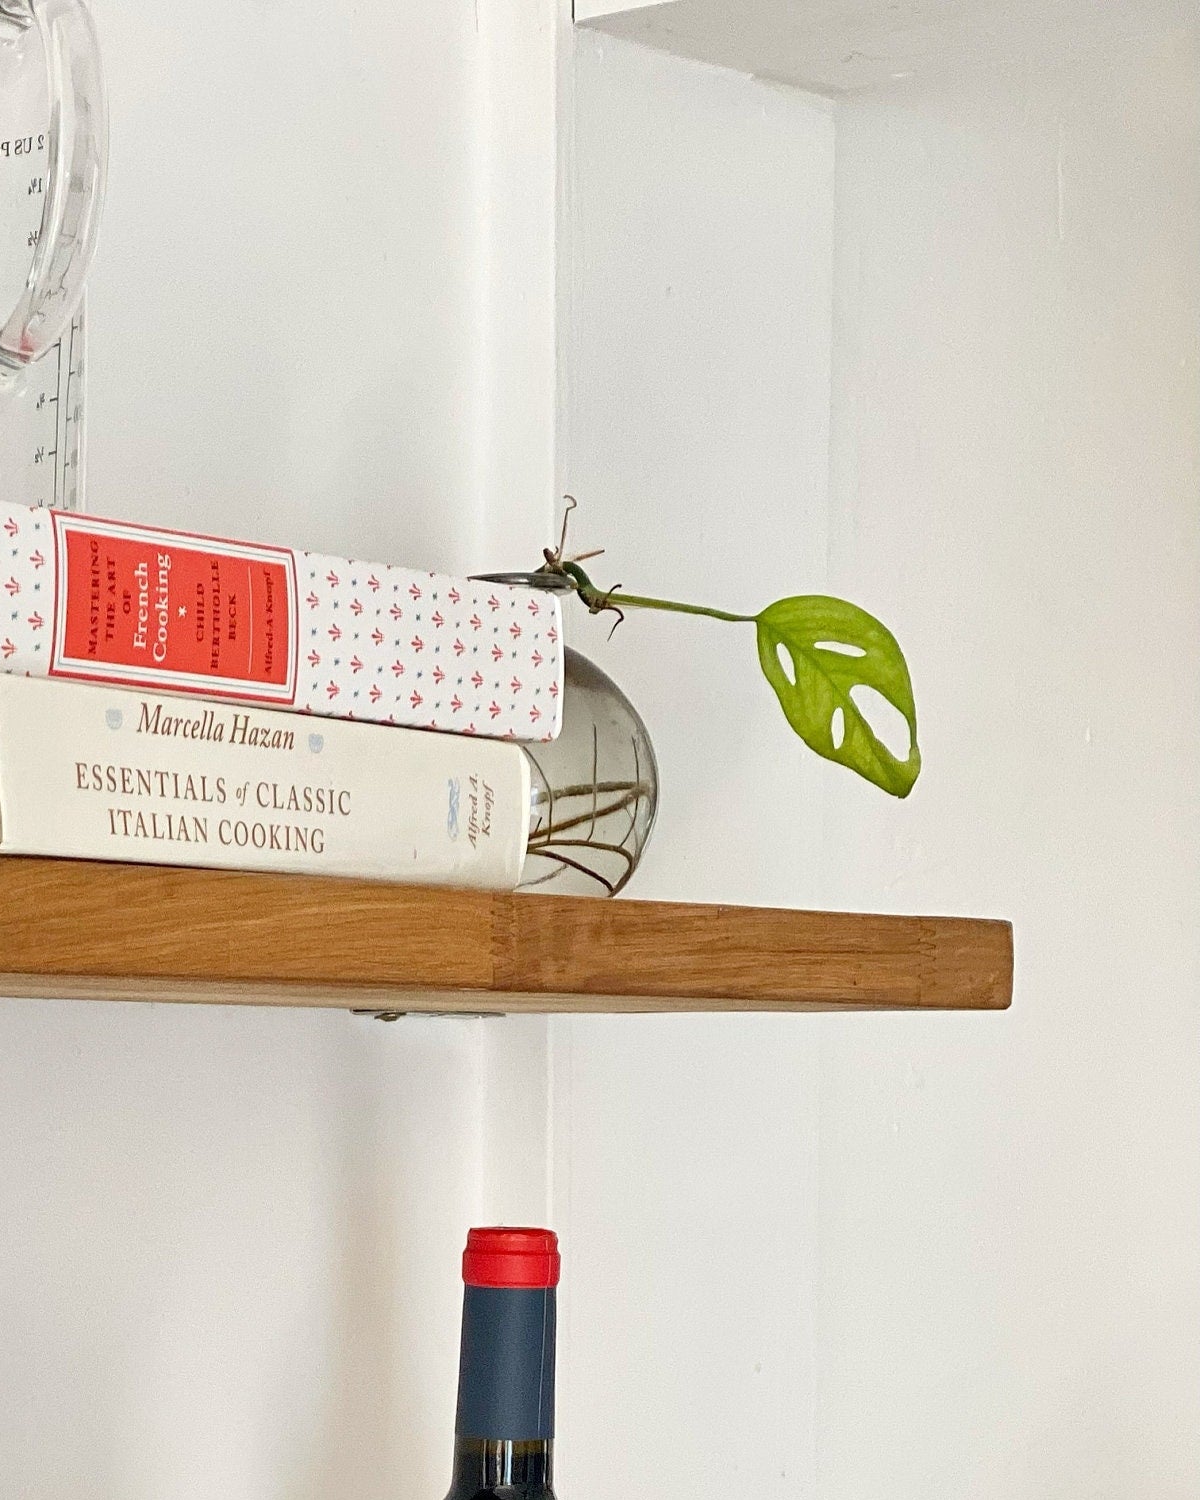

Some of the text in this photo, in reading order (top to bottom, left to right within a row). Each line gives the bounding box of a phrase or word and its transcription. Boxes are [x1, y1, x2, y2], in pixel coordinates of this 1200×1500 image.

[88, 540, 100, 655] MASTERING
[105, 555, 116, 642] THE ART
[122, 590, 131, 614] OF
[133, 562, 149, 650] French
[153, 552, 172, 662] Cooking
[196, 583, 204, 643] CHILD
[228, 593, 237, 640] BECK
[137, 701, 295, 750] Marcella Hazan
[75, 761, 352, 816] ESSENTIALS of CLASSIC
[482, 779, 495, 837] Knopf
[107, 807, 326, 854] ITALIAN COOKING
[467, 793, 481, 850] Alfred
